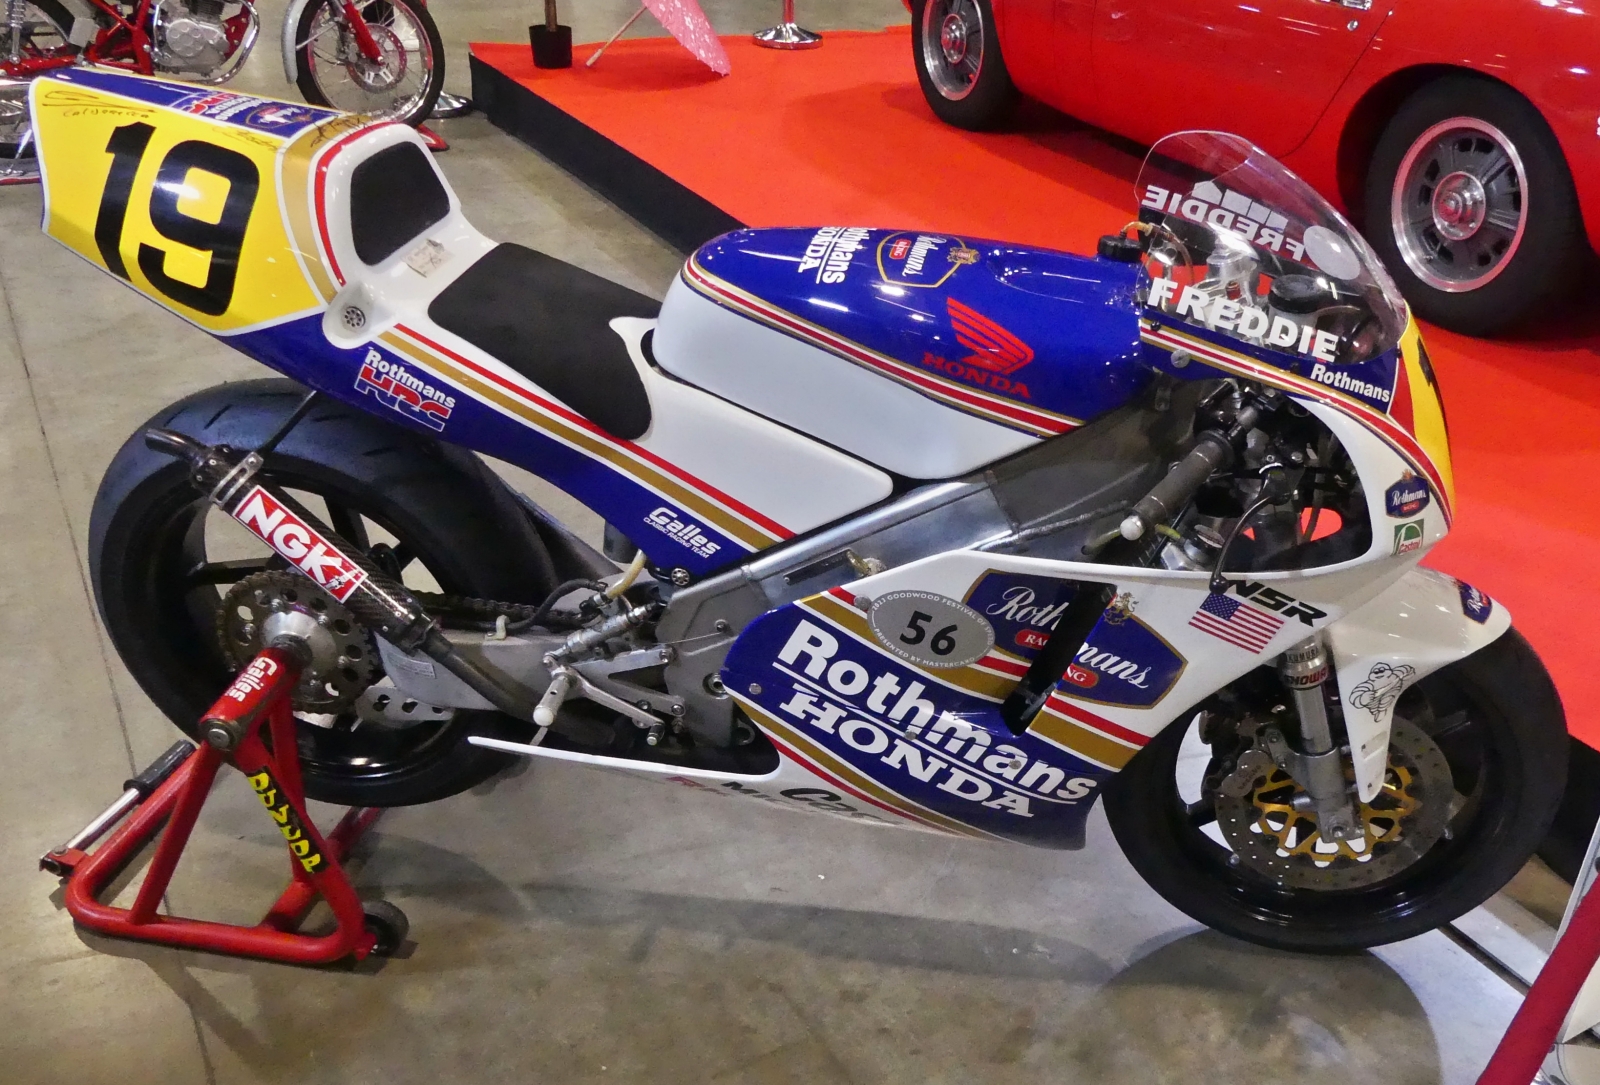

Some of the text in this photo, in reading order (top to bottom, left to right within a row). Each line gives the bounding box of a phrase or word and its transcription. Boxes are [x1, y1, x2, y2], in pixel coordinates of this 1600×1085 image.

[94, 121, 260, 316] 19
[1147, 278, 1340, 362] FREDDIE
[354, 363, 452, 432] HRC
[365, 349, 456, 408] Rothmans
[921, 351, 1031, 399] HONDA
[1311, 365, 1390, 402] Rothmans
[1391, 490, 1426, 506] Rothmans
[237, 493, 343, 587] NGK
[643, 517, 710, 559] CLASSIC RACING TEAM
[649, 507, 721, 555] Galles
[887, 592, 940, 602] GOODWOOD
[942, 598, 977, 619] FESTIVAL
[976, 617, 986, 626] OF
[984, 625, 993, 646] SPEED
[1226, 580, 1327, 628] NSR
[874, 628, 975, 668] PRESENTED BY MASTERCARD
[900, 610, 958, 656] 56
[778, 619, 1098, 800] Rothmans
[779, 683, 1034, 818] HONDA
